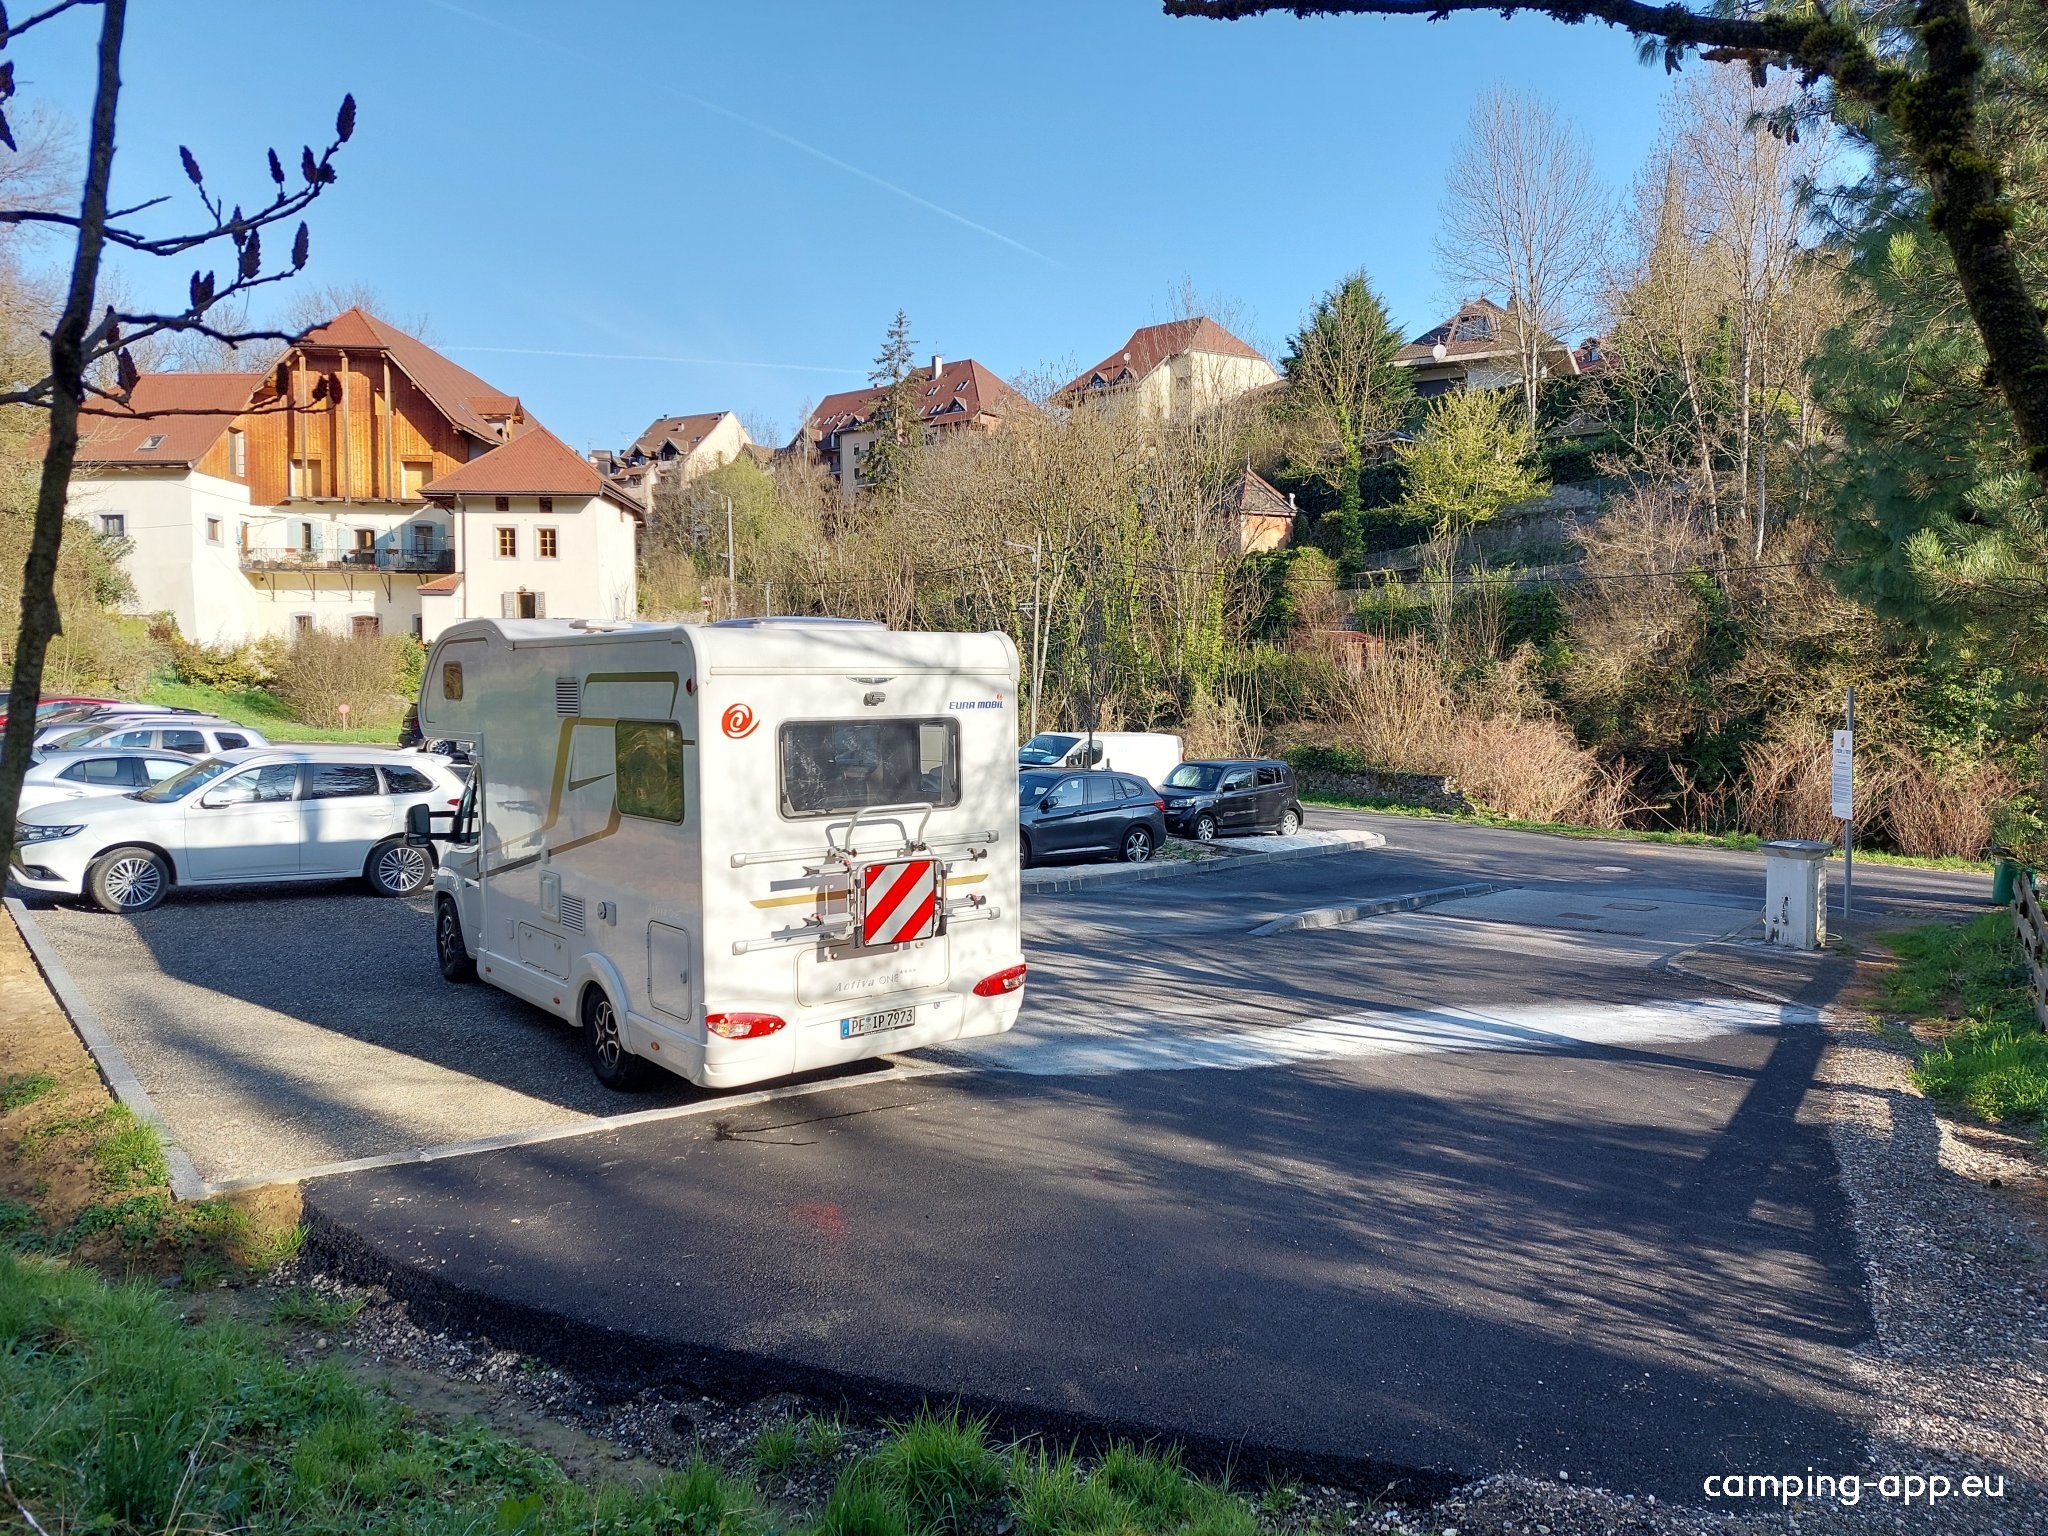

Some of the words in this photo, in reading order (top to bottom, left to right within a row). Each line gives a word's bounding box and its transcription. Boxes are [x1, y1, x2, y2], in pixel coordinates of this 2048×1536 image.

[949, 701, 976, 710] EURA
[977, 700, 1004, 709] MOBIL
[835, 979, 875, 992] Activa
[879, 974, 899, 984] ONE
[851, 1018, 866, 1033] PF
[873, 1014, 885, 1029] IP
[887, 1009, 913, 1026] 7973
